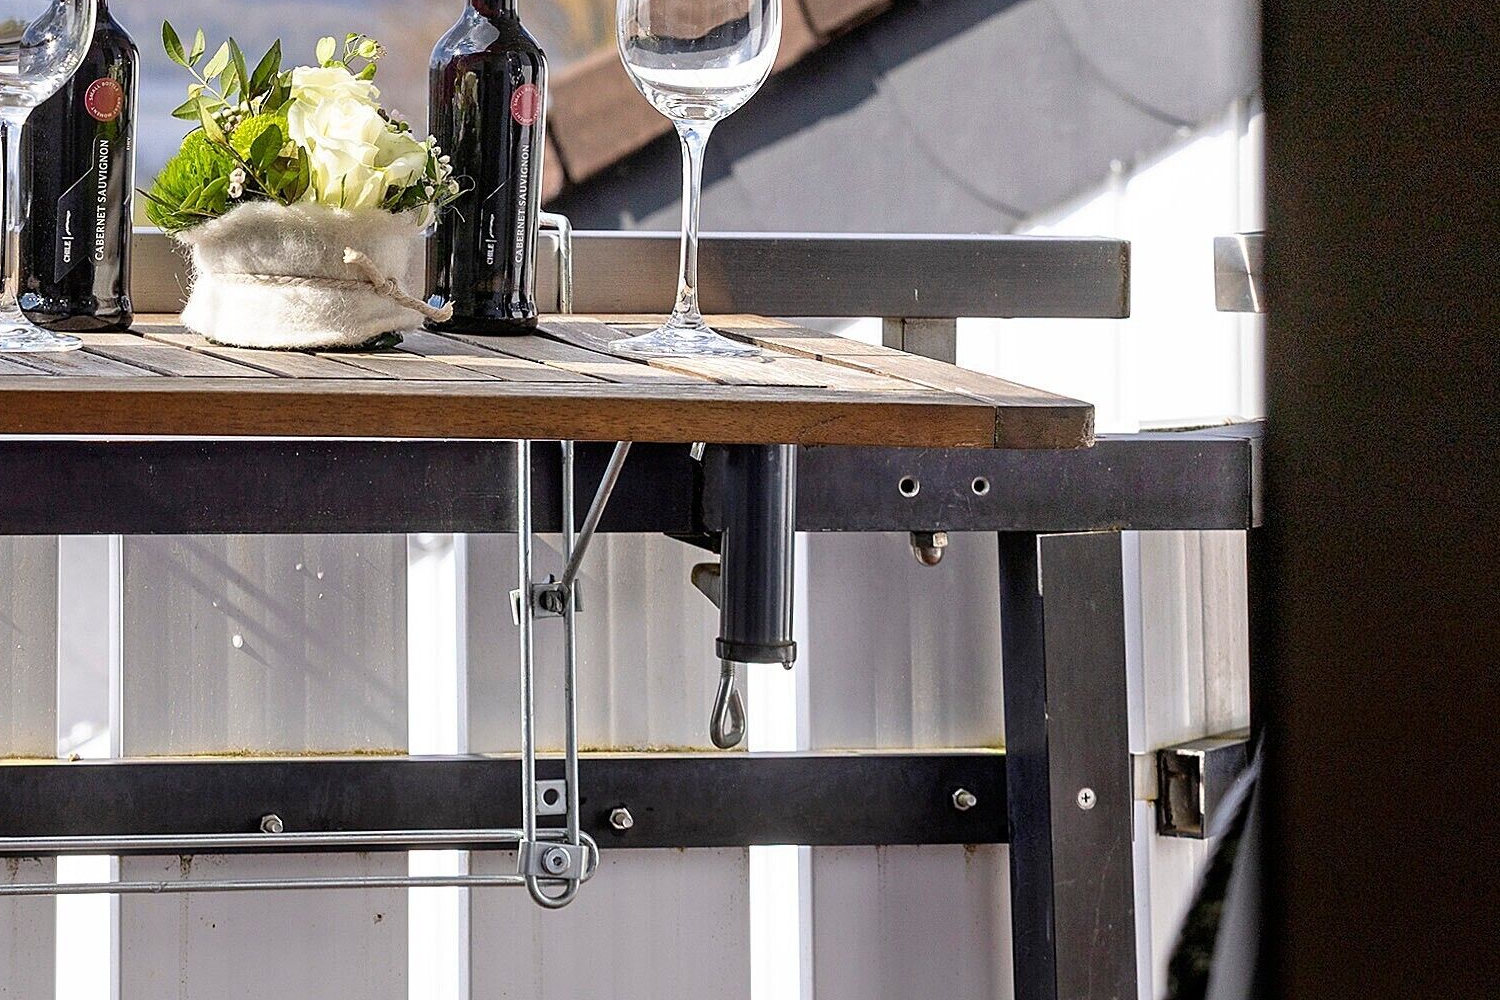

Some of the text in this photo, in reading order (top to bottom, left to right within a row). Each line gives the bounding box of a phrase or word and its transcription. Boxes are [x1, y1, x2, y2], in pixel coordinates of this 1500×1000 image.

[88, 84, 101, 101] SMALL
[94, 139, 109, 261] CABERNET SAUVIGNON
[514, 144, 530, 263] CABERNET SAUVIGNON
